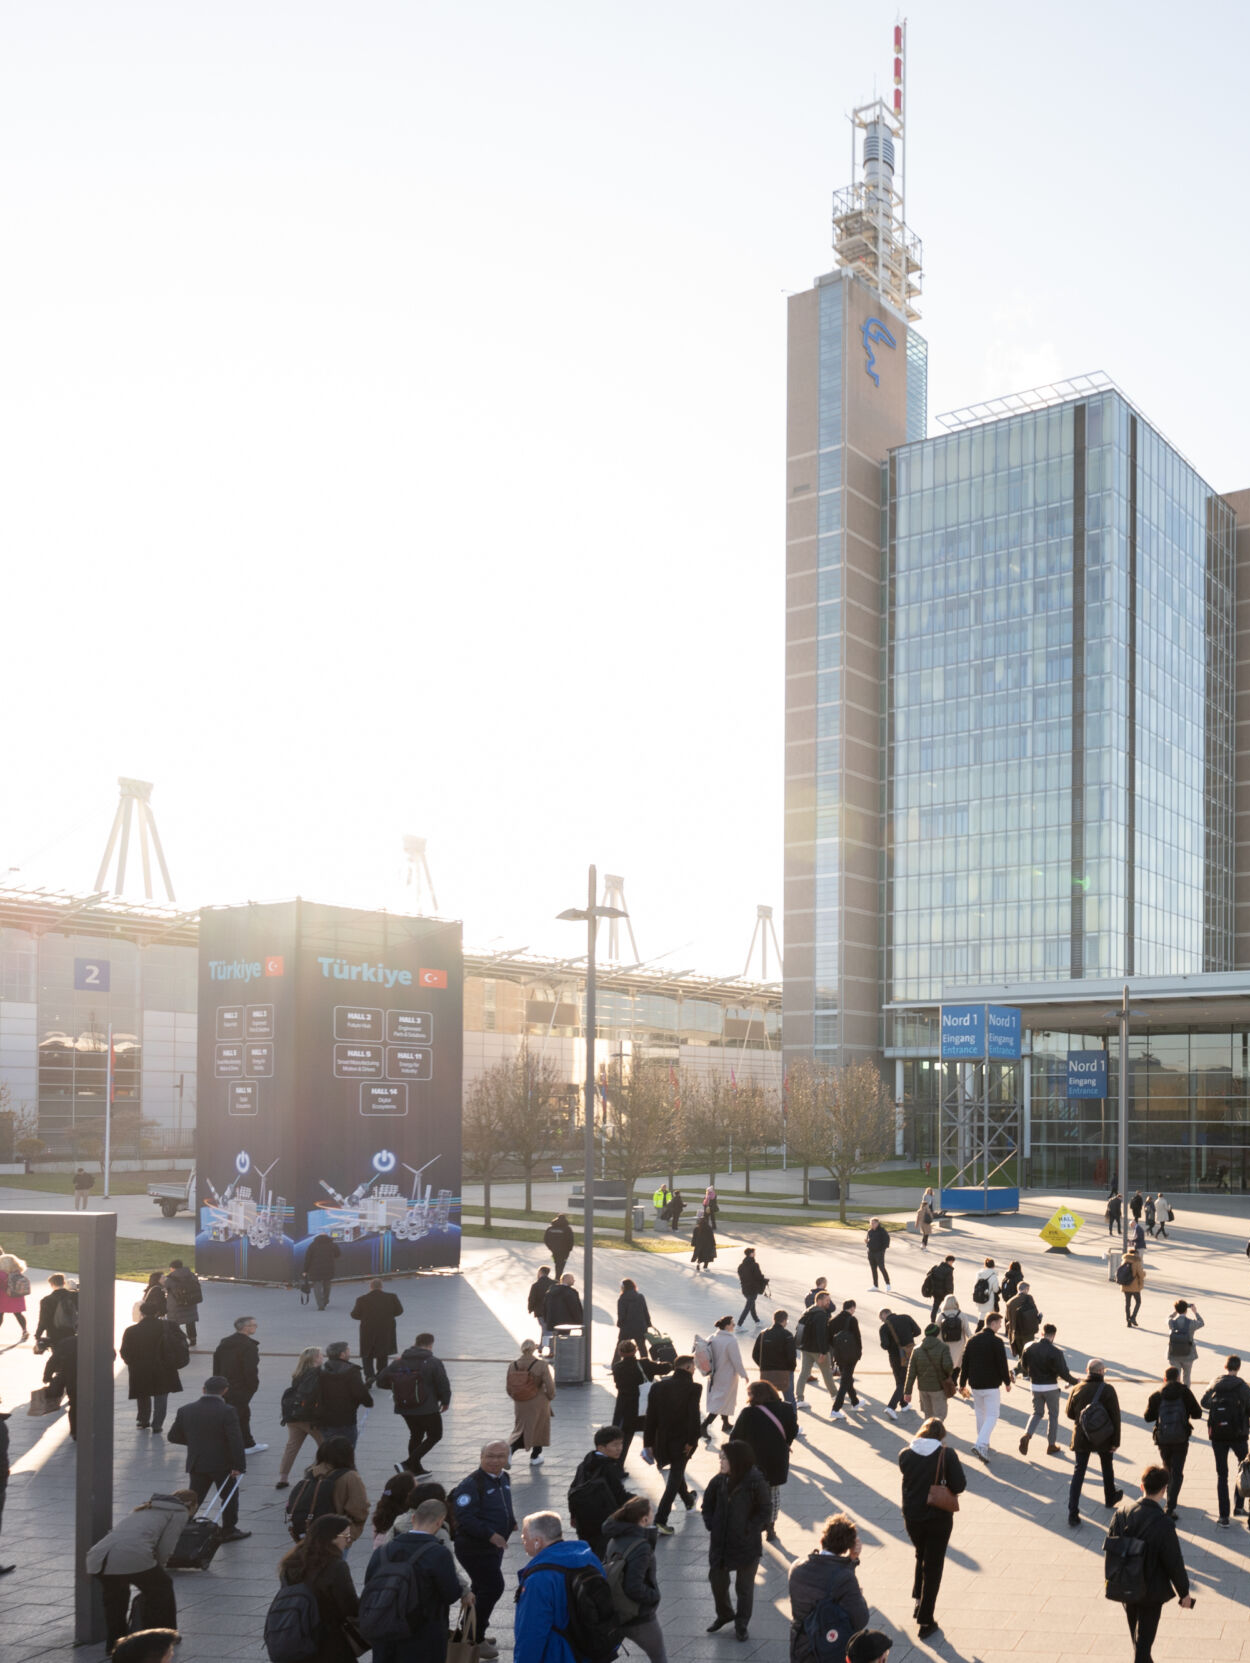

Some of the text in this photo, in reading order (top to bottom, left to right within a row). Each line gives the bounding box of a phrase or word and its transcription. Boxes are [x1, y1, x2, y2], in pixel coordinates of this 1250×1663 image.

[86, 965, 100, 984] 2
[208, 958, 261, 983] Türkiye
[318, 956, 412, 988] Türkiye
[943, 1013, 977, 1026] Nord 1
[989, 1014, 1015, 1027] Nord 1
[943, 1034, 976, 1045] Eingang
[989, 1033, 1014, 1046] Eingang
[943, 1046, 977, 1054] Entrance
[989, 1046, 1016, 1055] Entrance
[1069, 1059, 1105, 1071] Nord 1
[1069, 1078, 1096, 1087] Eingang
